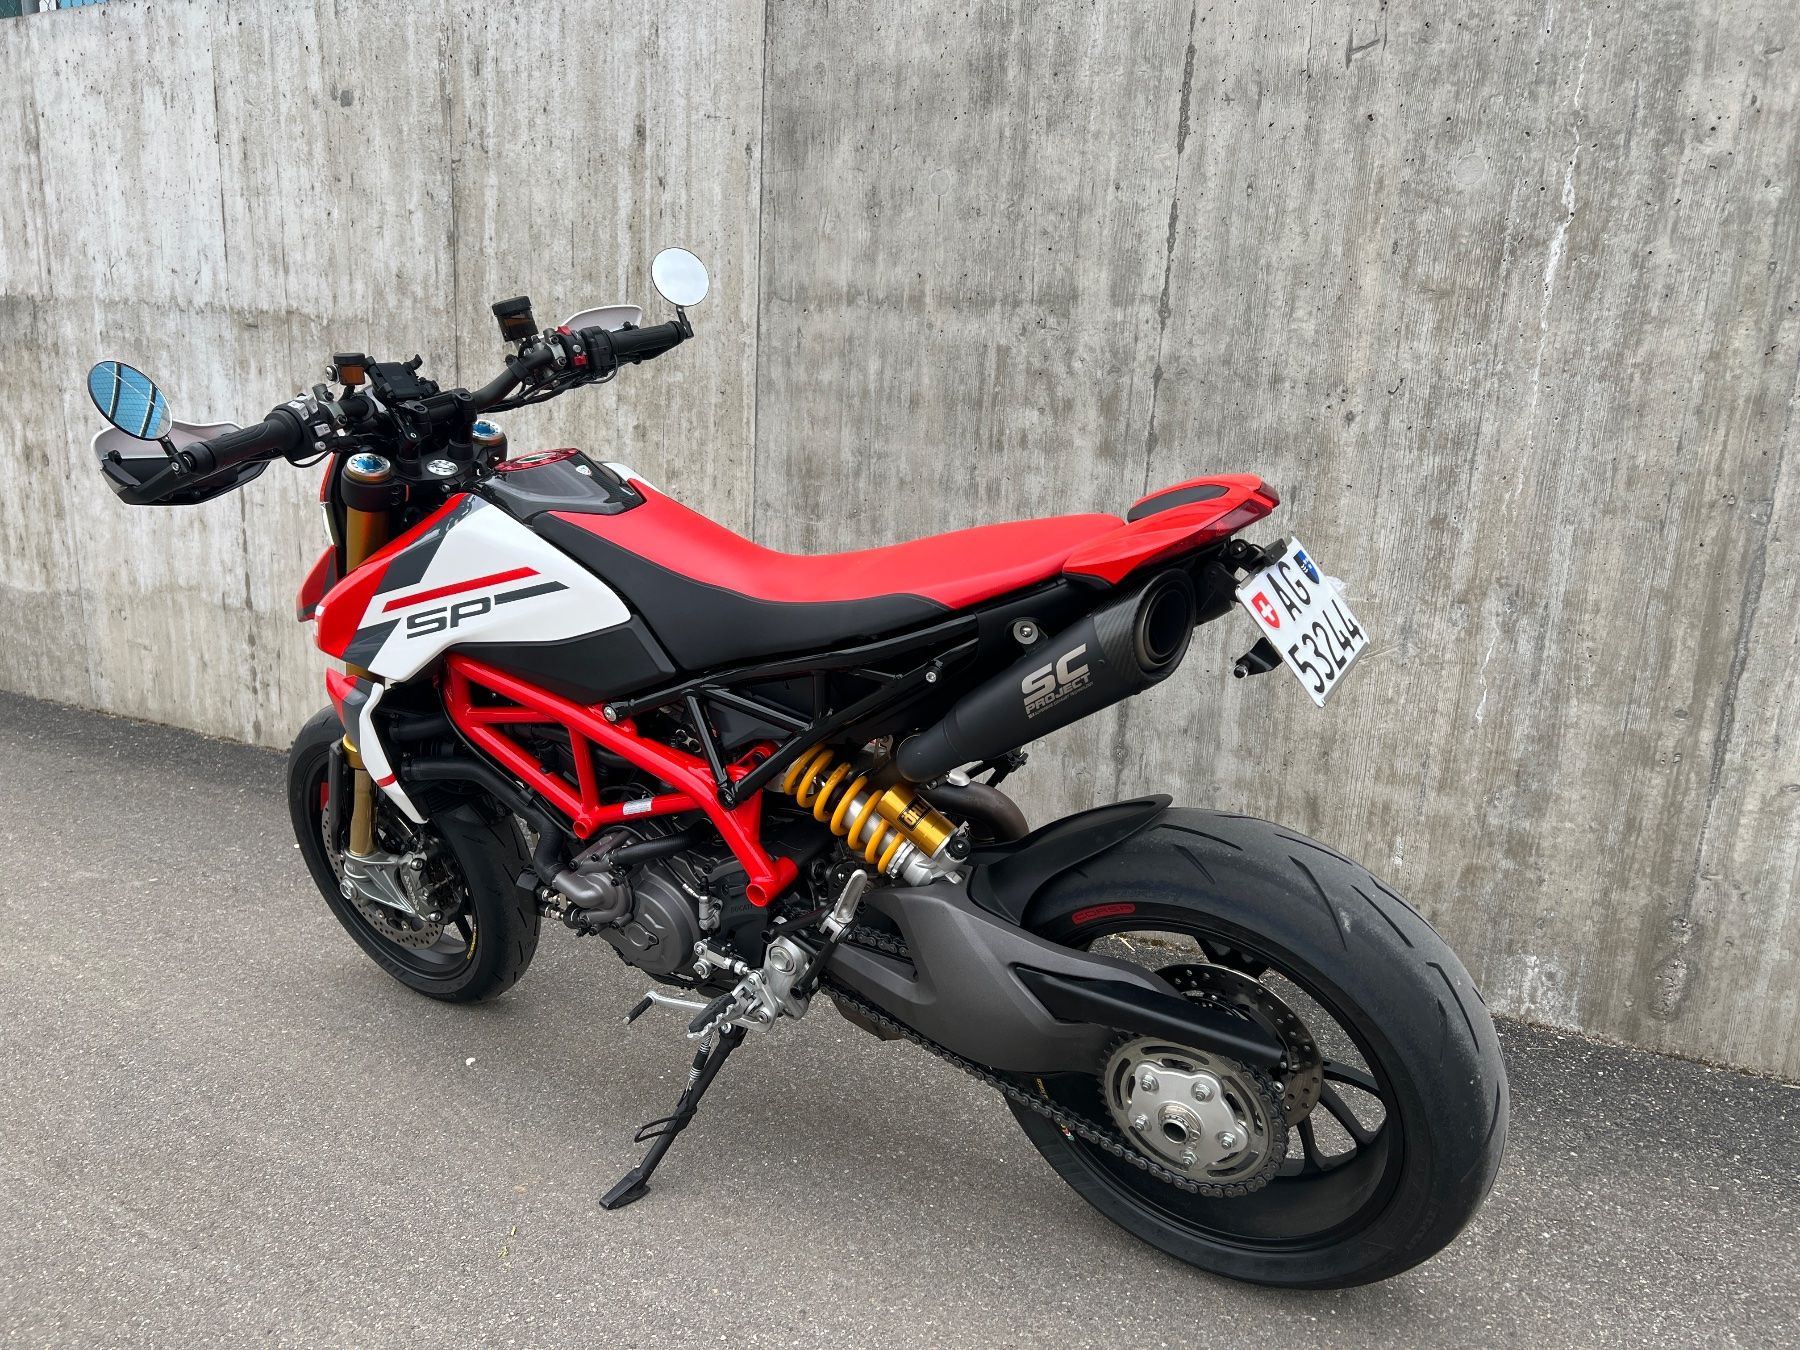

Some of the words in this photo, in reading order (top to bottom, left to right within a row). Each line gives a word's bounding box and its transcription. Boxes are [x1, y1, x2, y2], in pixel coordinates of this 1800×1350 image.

[407, 597, 491, 639] SP
[1266, 561, 1311, 621] AG
[1022, 643, 1089, 706] SC
[1288, 599, 1364, 693] 53244
[1025, 672, 1091, 715] PROJECT
